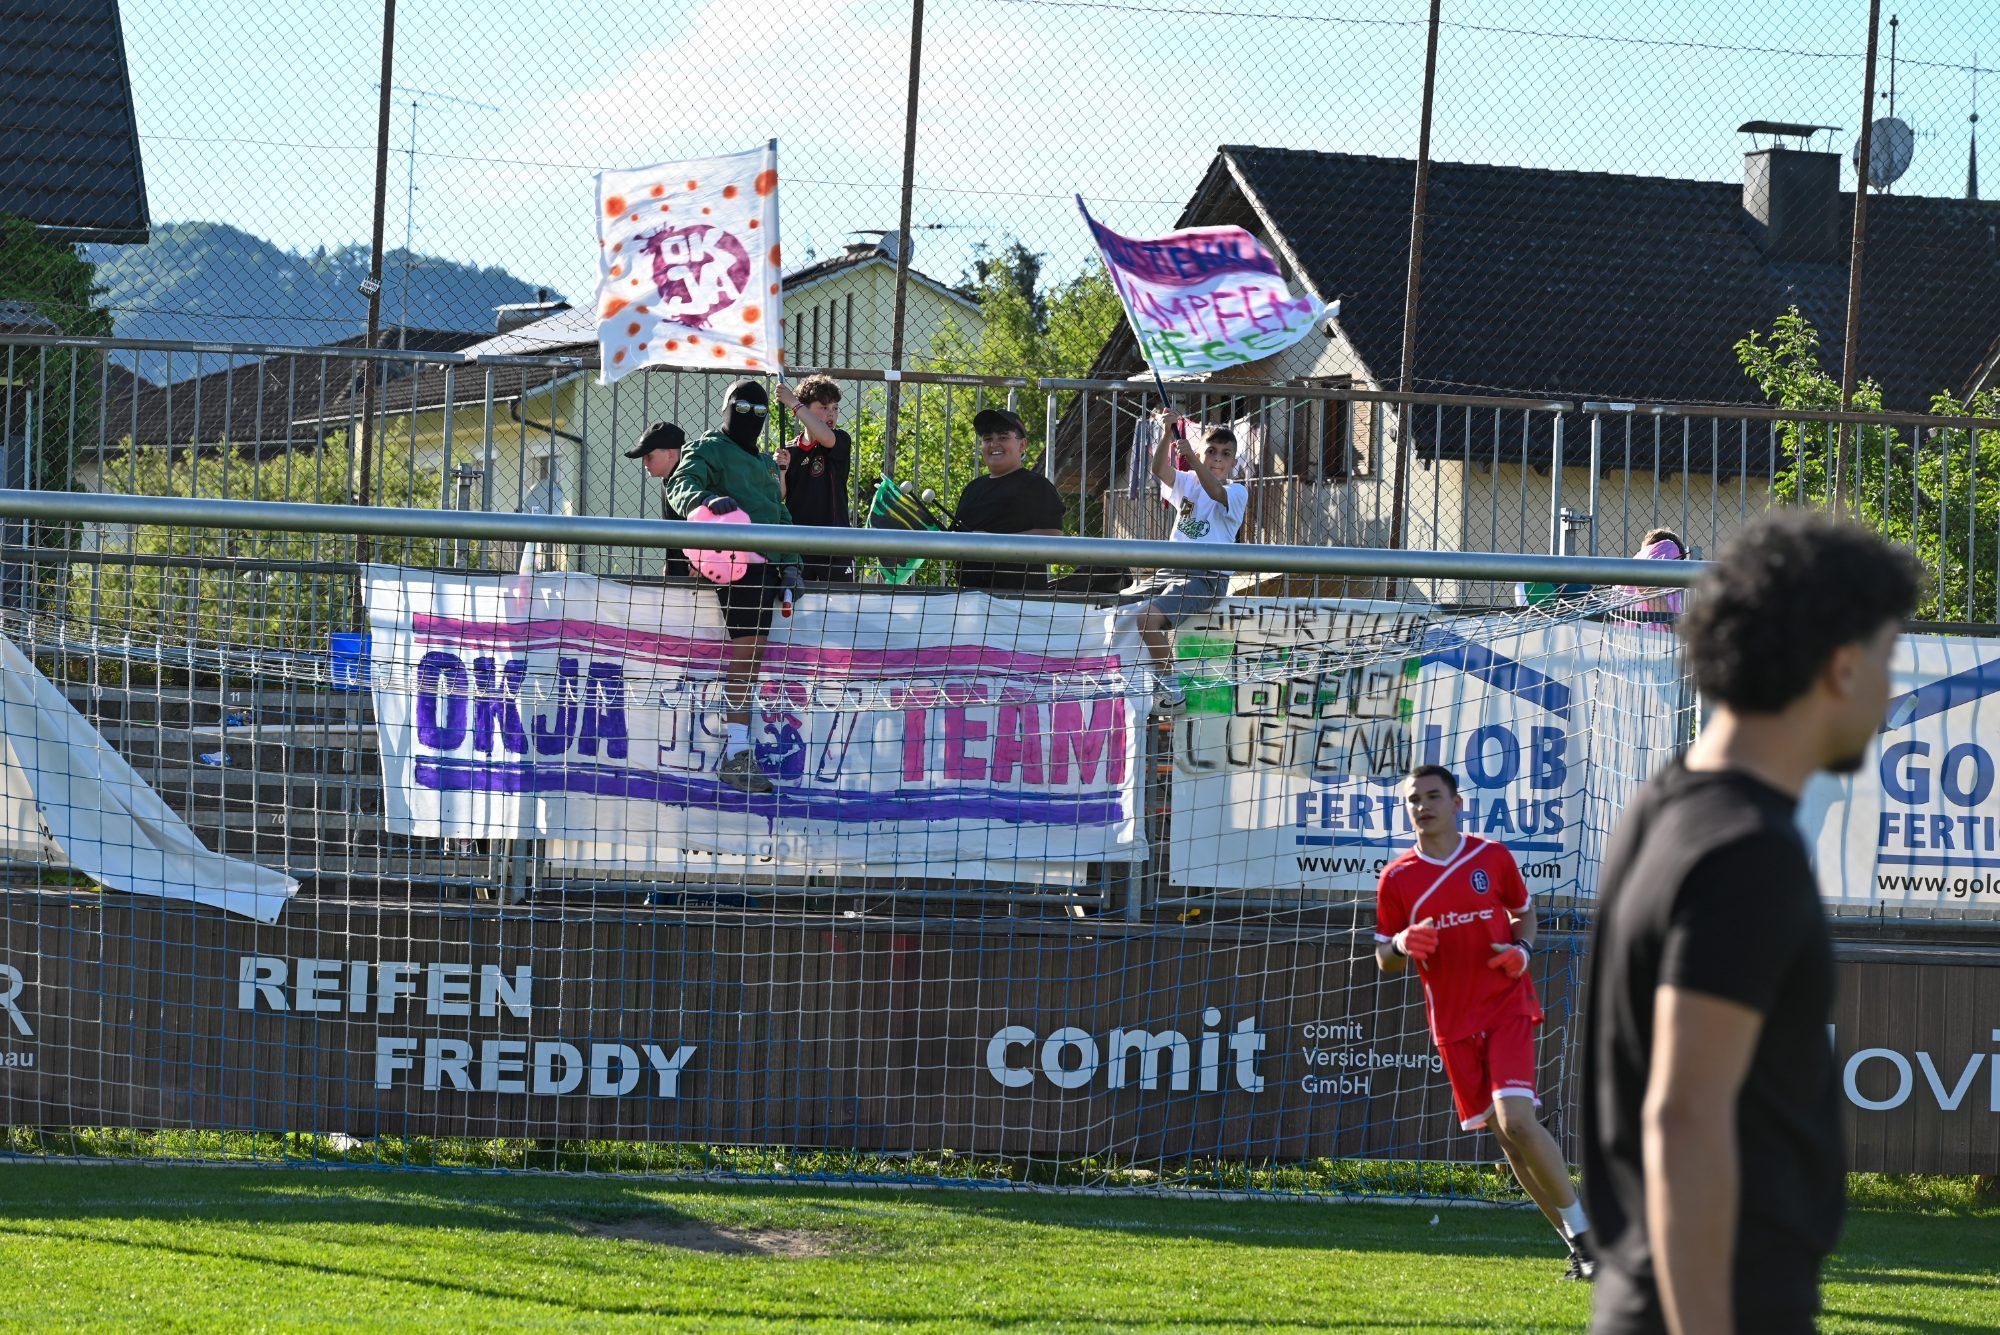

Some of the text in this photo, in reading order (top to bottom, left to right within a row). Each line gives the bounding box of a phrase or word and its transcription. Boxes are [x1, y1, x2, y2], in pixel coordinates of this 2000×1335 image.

[416, 651, 629, 759] OKJA
[890, 682, 1126, 786] TEAM
[1296, 791, 1565, 836] FERTIHAUS
[1877, 812, 2000, 851] FERTI
[237, 956, 532, 1018] REIFEN
[985, 1006, 1266, 1094] comit
[1302, 1019, 1364, 1040] comit
[0, 1050, 34, 1068] au
[375, 1036, 698, 1099] FREDDY
[1301, 1074, 1370, 1096] GmbH
